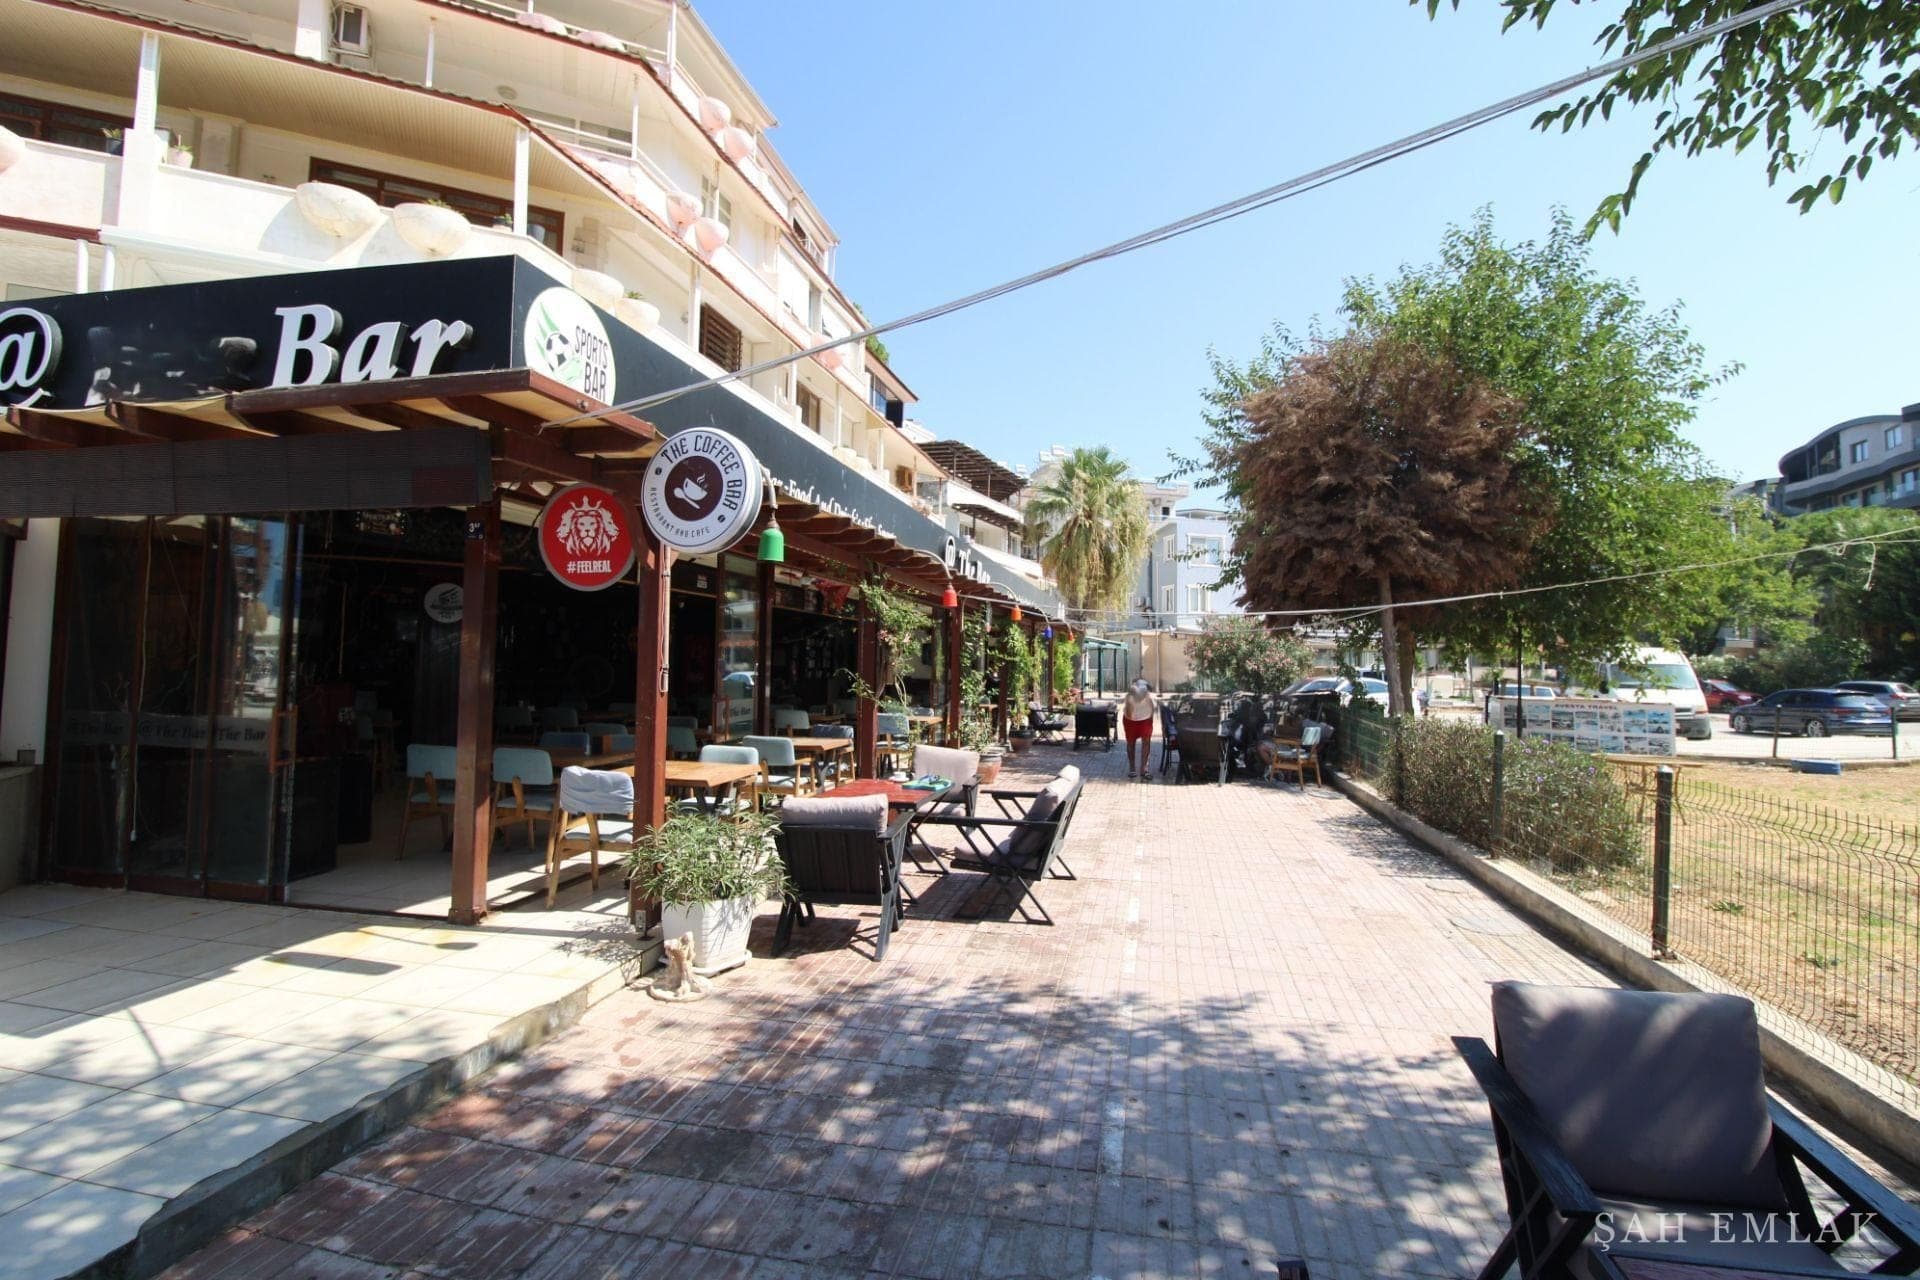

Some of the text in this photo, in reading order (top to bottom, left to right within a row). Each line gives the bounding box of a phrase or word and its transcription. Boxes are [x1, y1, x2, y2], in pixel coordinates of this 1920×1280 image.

[271, 304, 473, 387] Bar
[575, 325, 608, 370] SPORTS
[584, 361, 607, 402] BAR
[661, 435, 743, 511] THE COFFEE BAR
[675, 527, 689, 537] AND
[691, 526, 710, 537] CAFE
[567, 560, 612, 574] #FEELREAL
[242, 728, 267, 741] Bar
